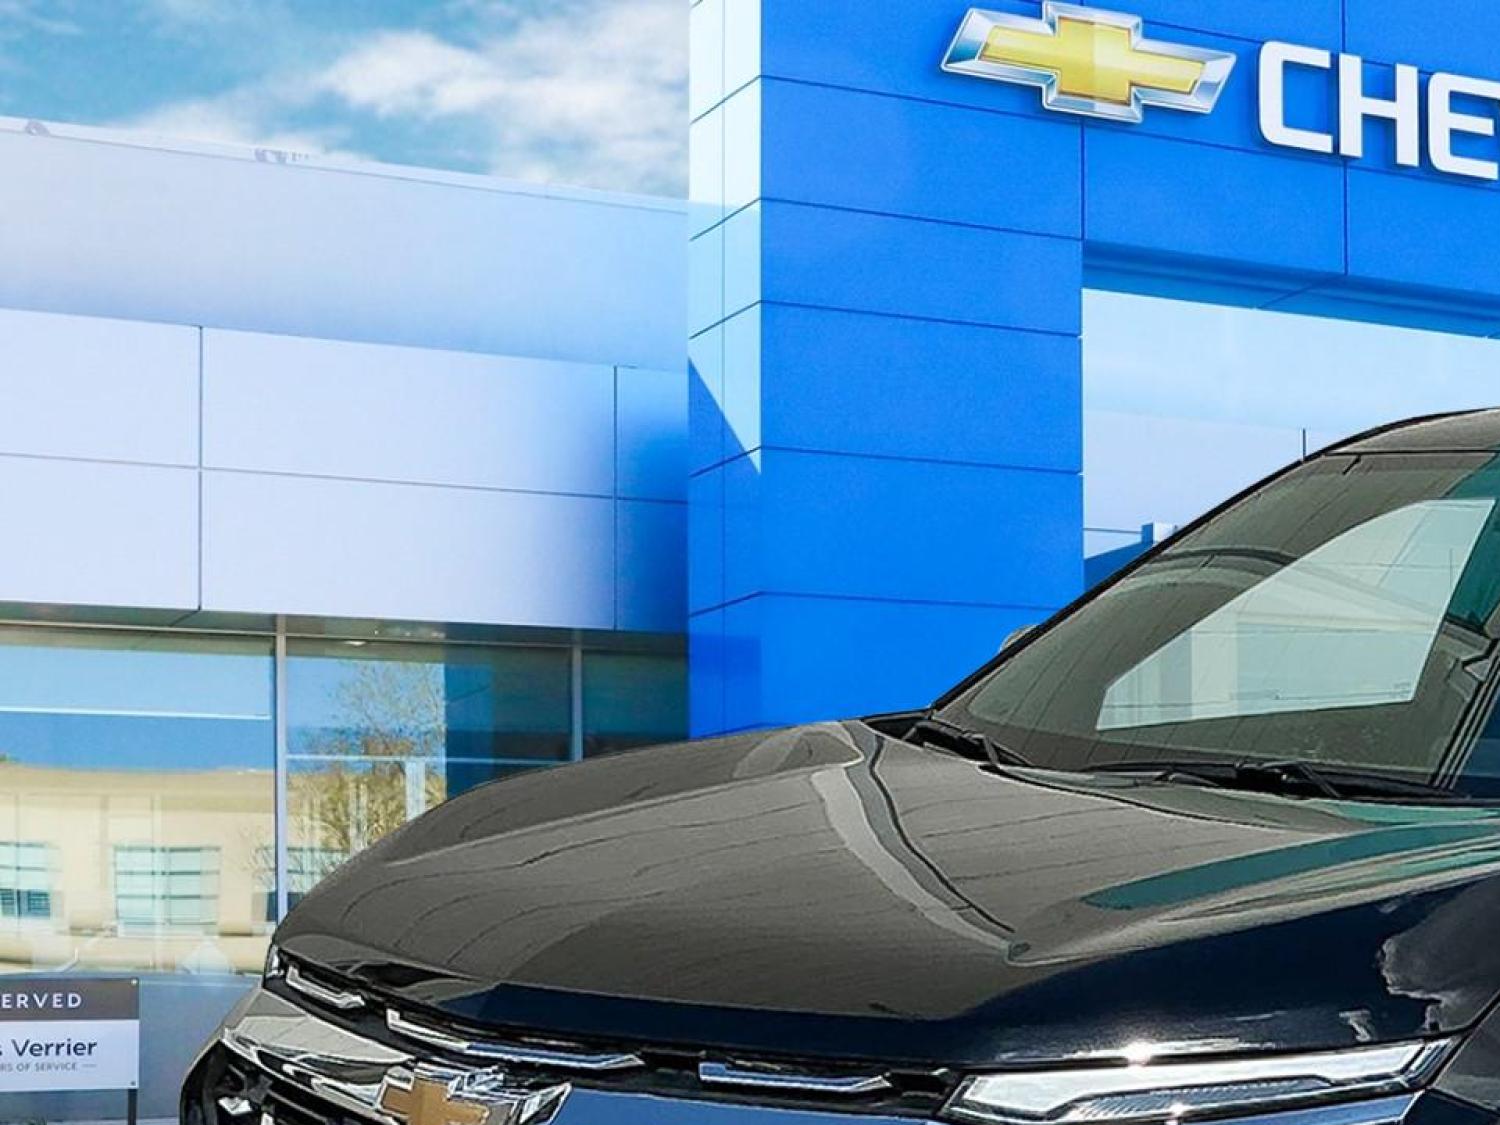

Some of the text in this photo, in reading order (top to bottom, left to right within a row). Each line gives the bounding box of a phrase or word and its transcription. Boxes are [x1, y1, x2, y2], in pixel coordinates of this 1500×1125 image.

[11, 1038, 98, 1057] Verrier
[16, 1062, 30, 1073] OF
[35, 1061, 78, 1072] SERVICE
